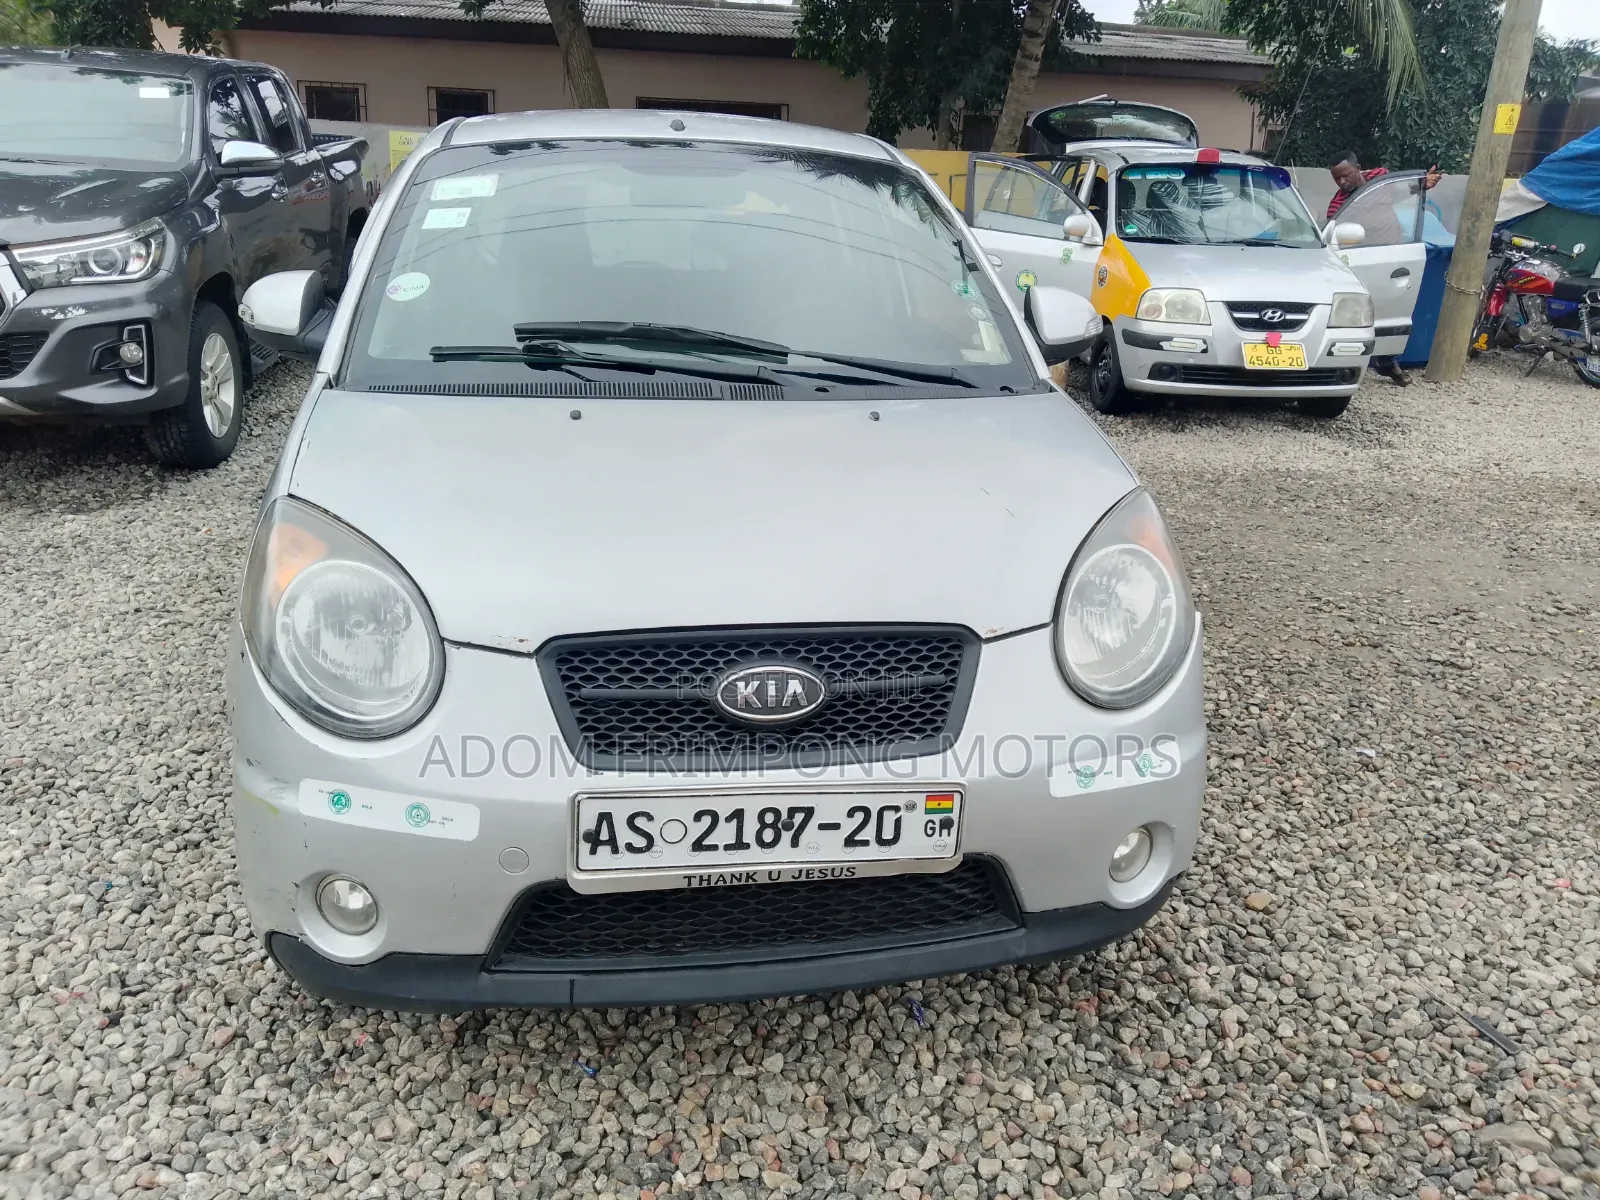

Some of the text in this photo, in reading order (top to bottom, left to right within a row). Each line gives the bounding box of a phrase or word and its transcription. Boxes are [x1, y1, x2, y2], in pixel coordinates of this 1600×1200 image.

[403, 284, 425, 293] CIMA
[1266, 345, 1283, 355] GG
[1248, 356, 1303, 367] 4540-20
[735, 679, 809, 709] KIA
[588, 811, 656, 856] AS
[691, 805, 903, 852] 2187-20
[682, 866, 857, 888] THANK U JESUS
